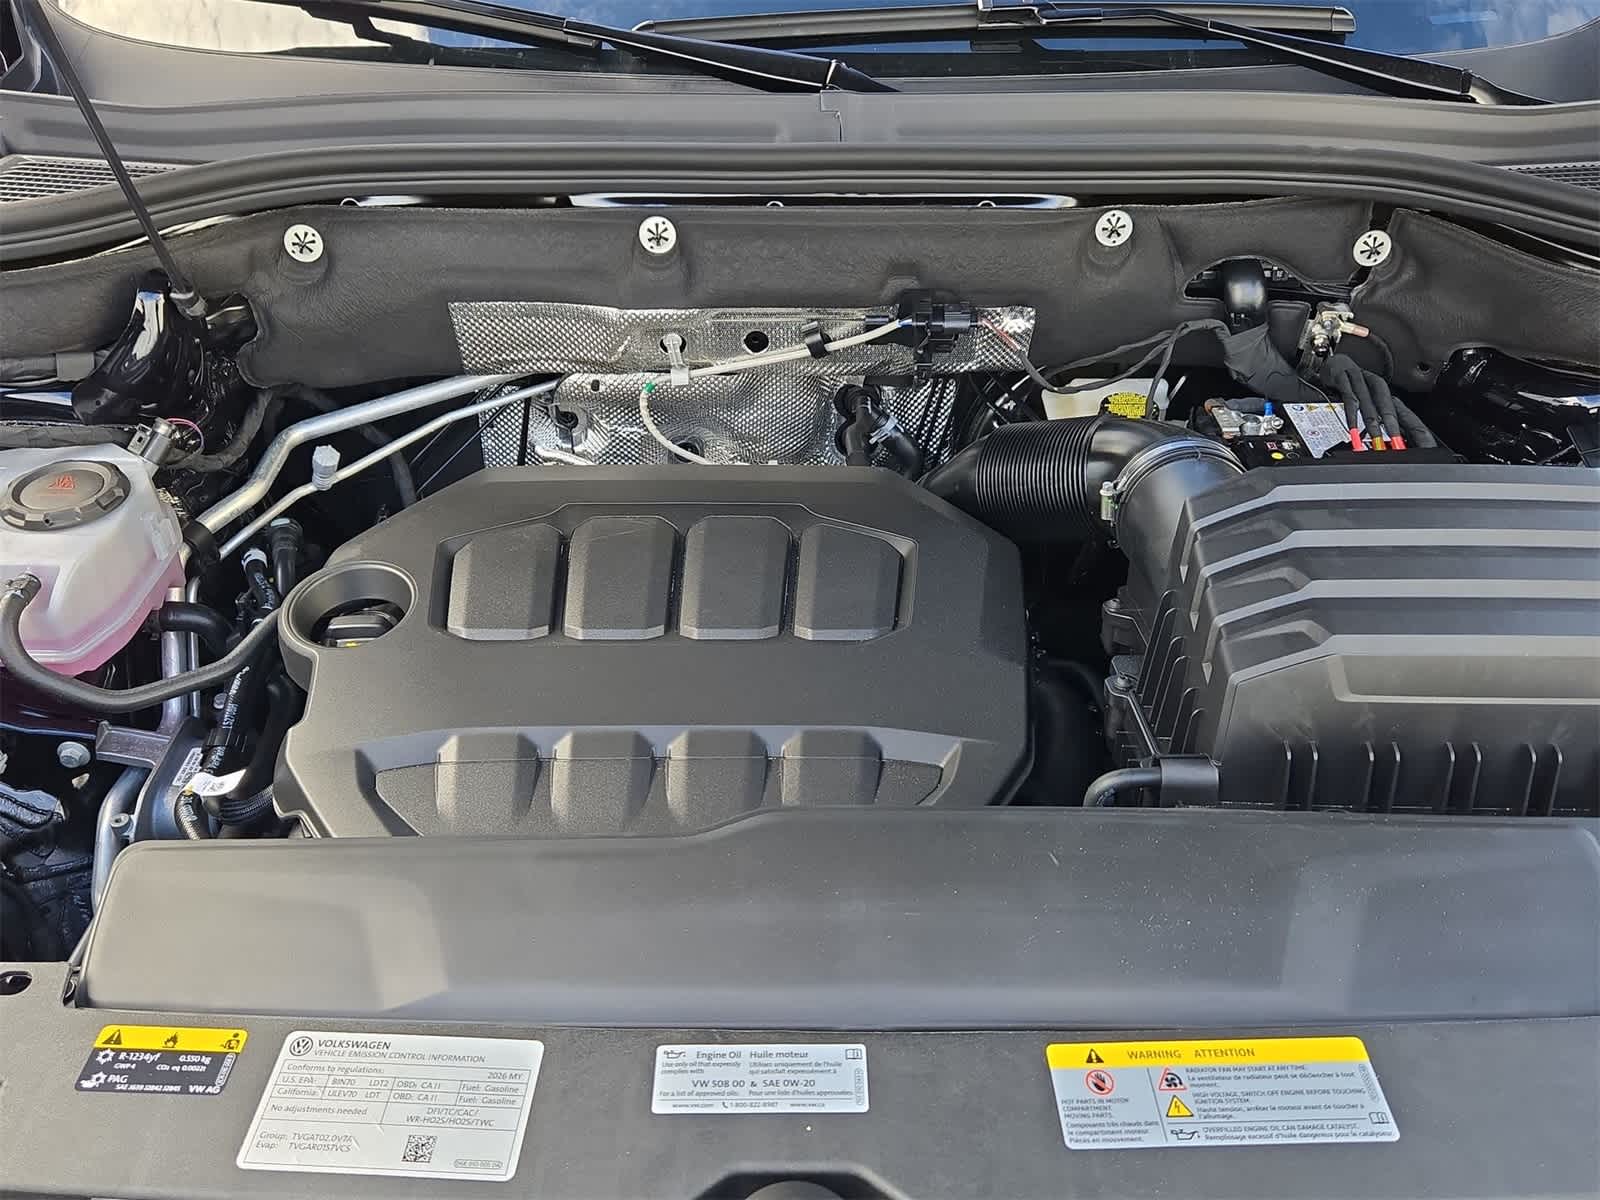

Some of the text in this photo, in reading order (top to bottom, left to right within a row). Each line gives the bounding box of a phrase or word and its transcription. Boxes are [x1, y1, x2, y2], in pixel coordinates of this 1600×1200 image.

[318, 1039, 391, 1050] VOLKSWAGEN
[118, 1052, 162, 1063] R-1234yf
[201, 1055, 212, 1065] kg
[348, 1050, 386, 1059] EMISSION
[388, 1051, 425, 1061] CONTROL
[427, 1053, 486, 1063] INFORMATION
[696, 1051, 742, 1061] Engine Oil
[749, 1050, 809, 1059] Huile moteur
[1127, 1048, 1256, 1060] WARNING ATTENTION
[287, 1063, 325, 1072] Conforms
[107, 1074, 129, 1083] PAG
[487, 1071, 523, 1080] 2026 MY
[331, 1078, 356, 1086] BIN70
[368, 1079, 389, 1087] LDT2
[692, 1080, 710, 1088] VW
[711, 1079, 730, 1088] 508
[732, 1079, 746, 1088] 00
[762, 1079, 781, 1088] SAE
[782, 1079, 816, 1088] 0W-20
[188, 1085, 221, 1094] VW AG
[461, 1083, 519, 1093] Fuel: Gasoline
[327, 1089, 358, 1098] ULEV70
[365, 1091, 381, 1099] LDT
[458, 1095, 517, 1105] Fuel: Gasoline
[270, 1103, 368, 1115] No adjustments needed
[258, 1131, 288, 1141] Group:
[256, 1142, 278, 1150] Evap:
